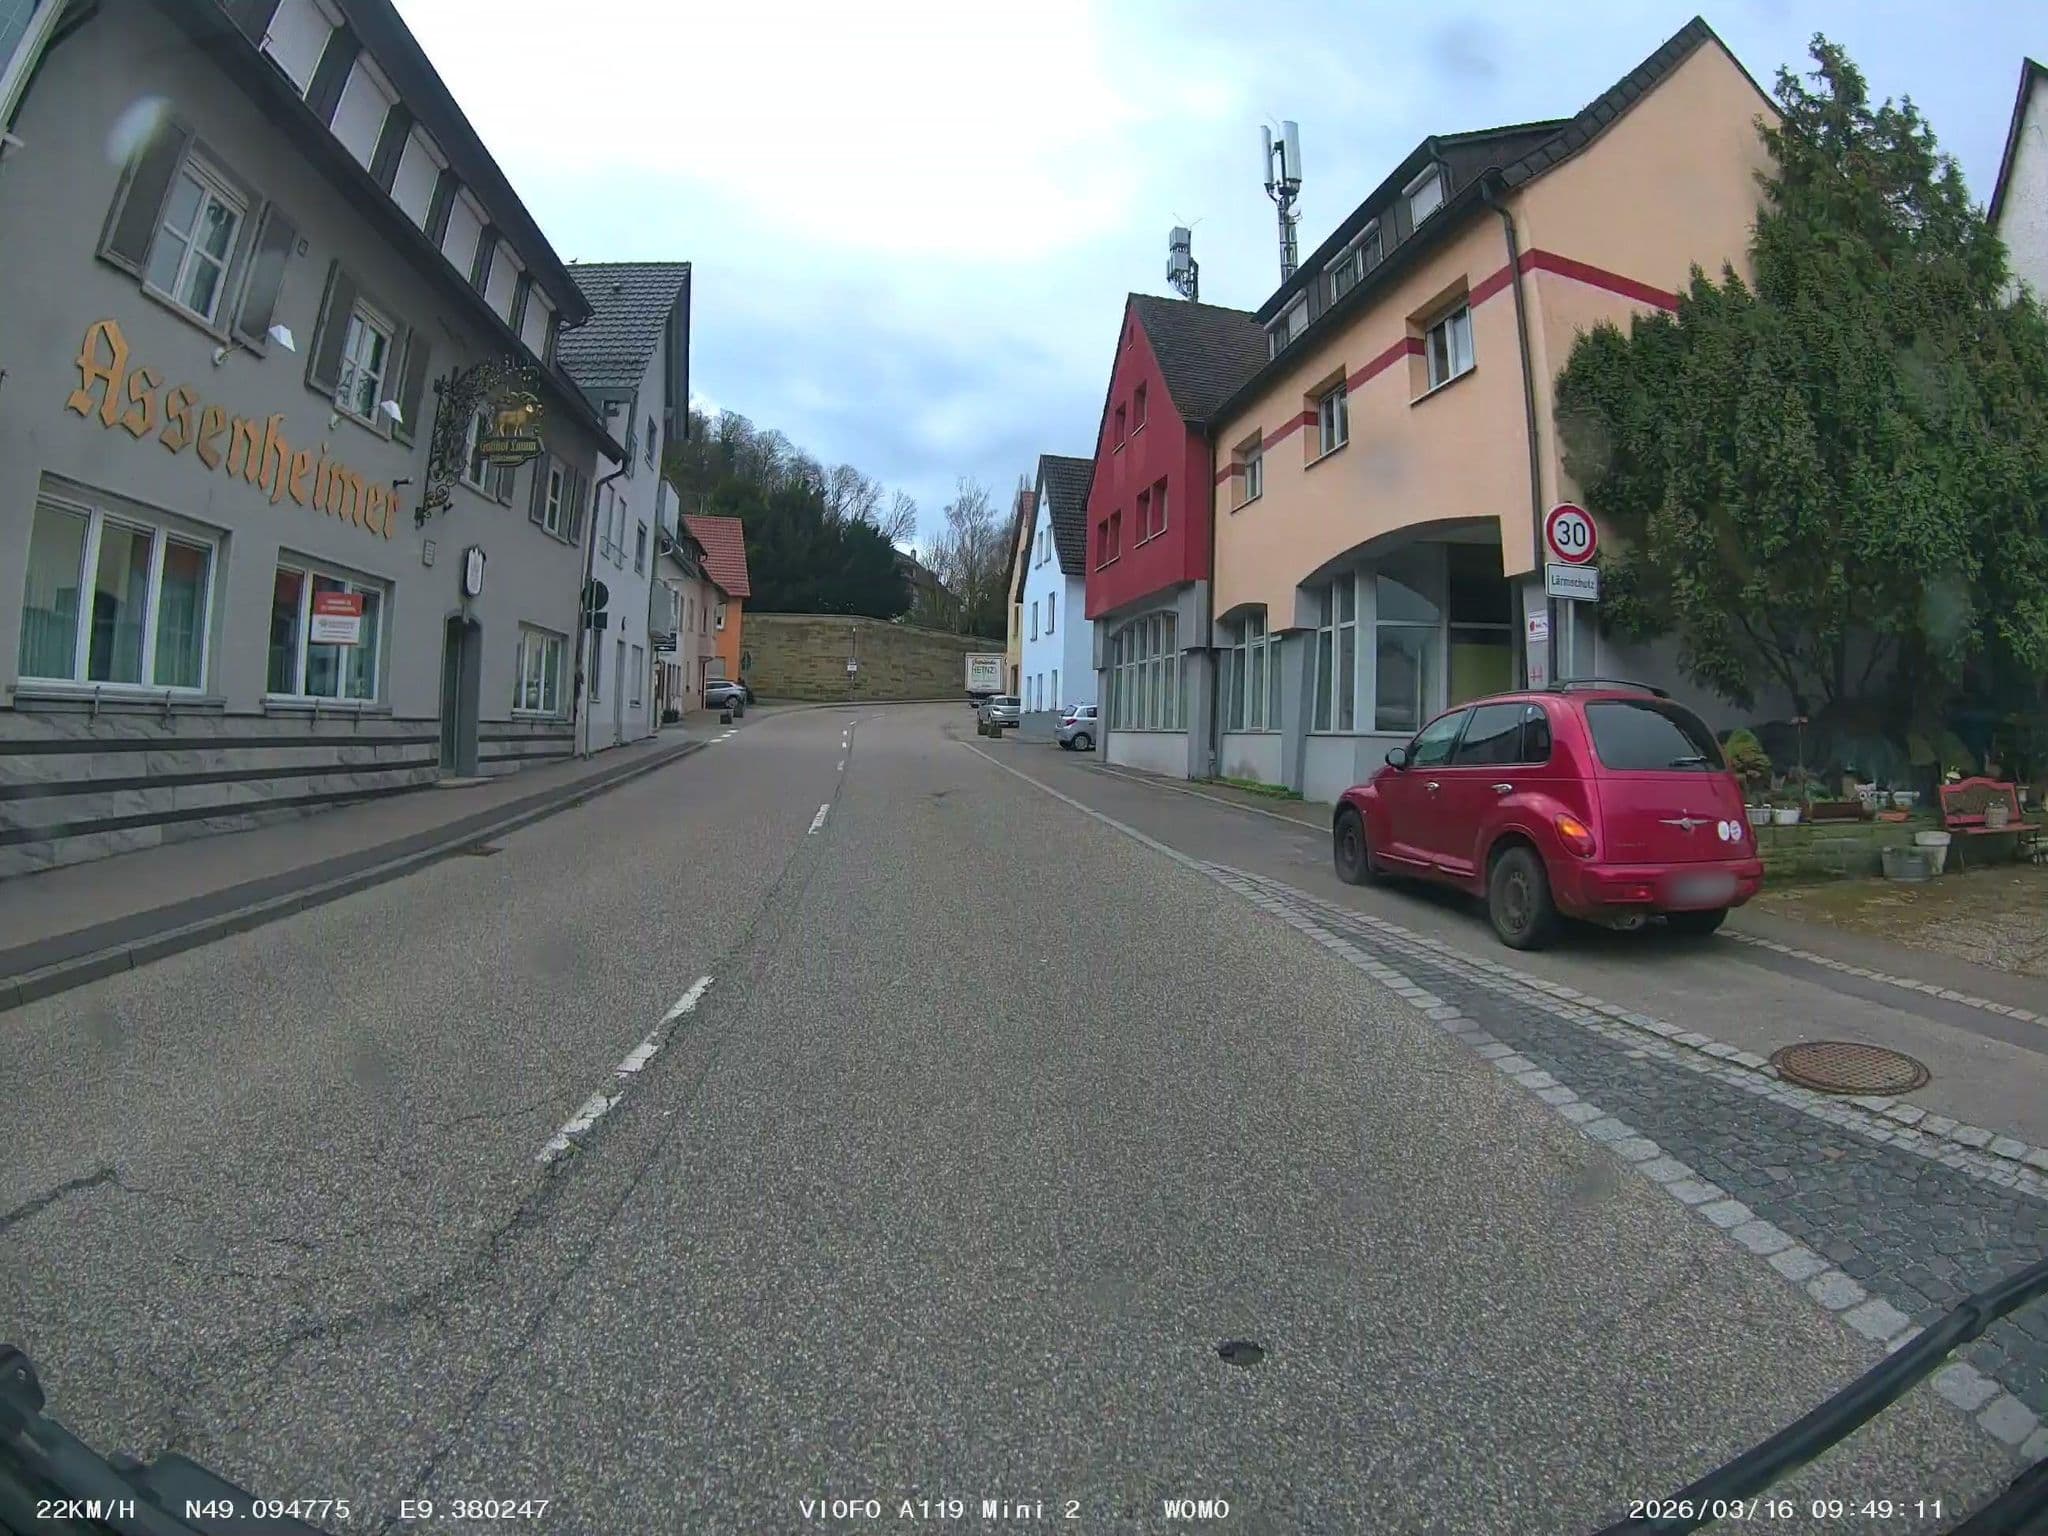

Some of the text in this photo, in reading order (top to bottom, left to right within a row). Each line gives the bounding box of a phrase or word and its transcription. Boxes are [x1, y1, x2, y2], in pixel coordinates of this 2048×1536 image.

[66, 319, 400, 538] Assenheimer
[1558, 520, 1586, 547] 30
[1551, 575, 1594, 589] Lärmschutz
